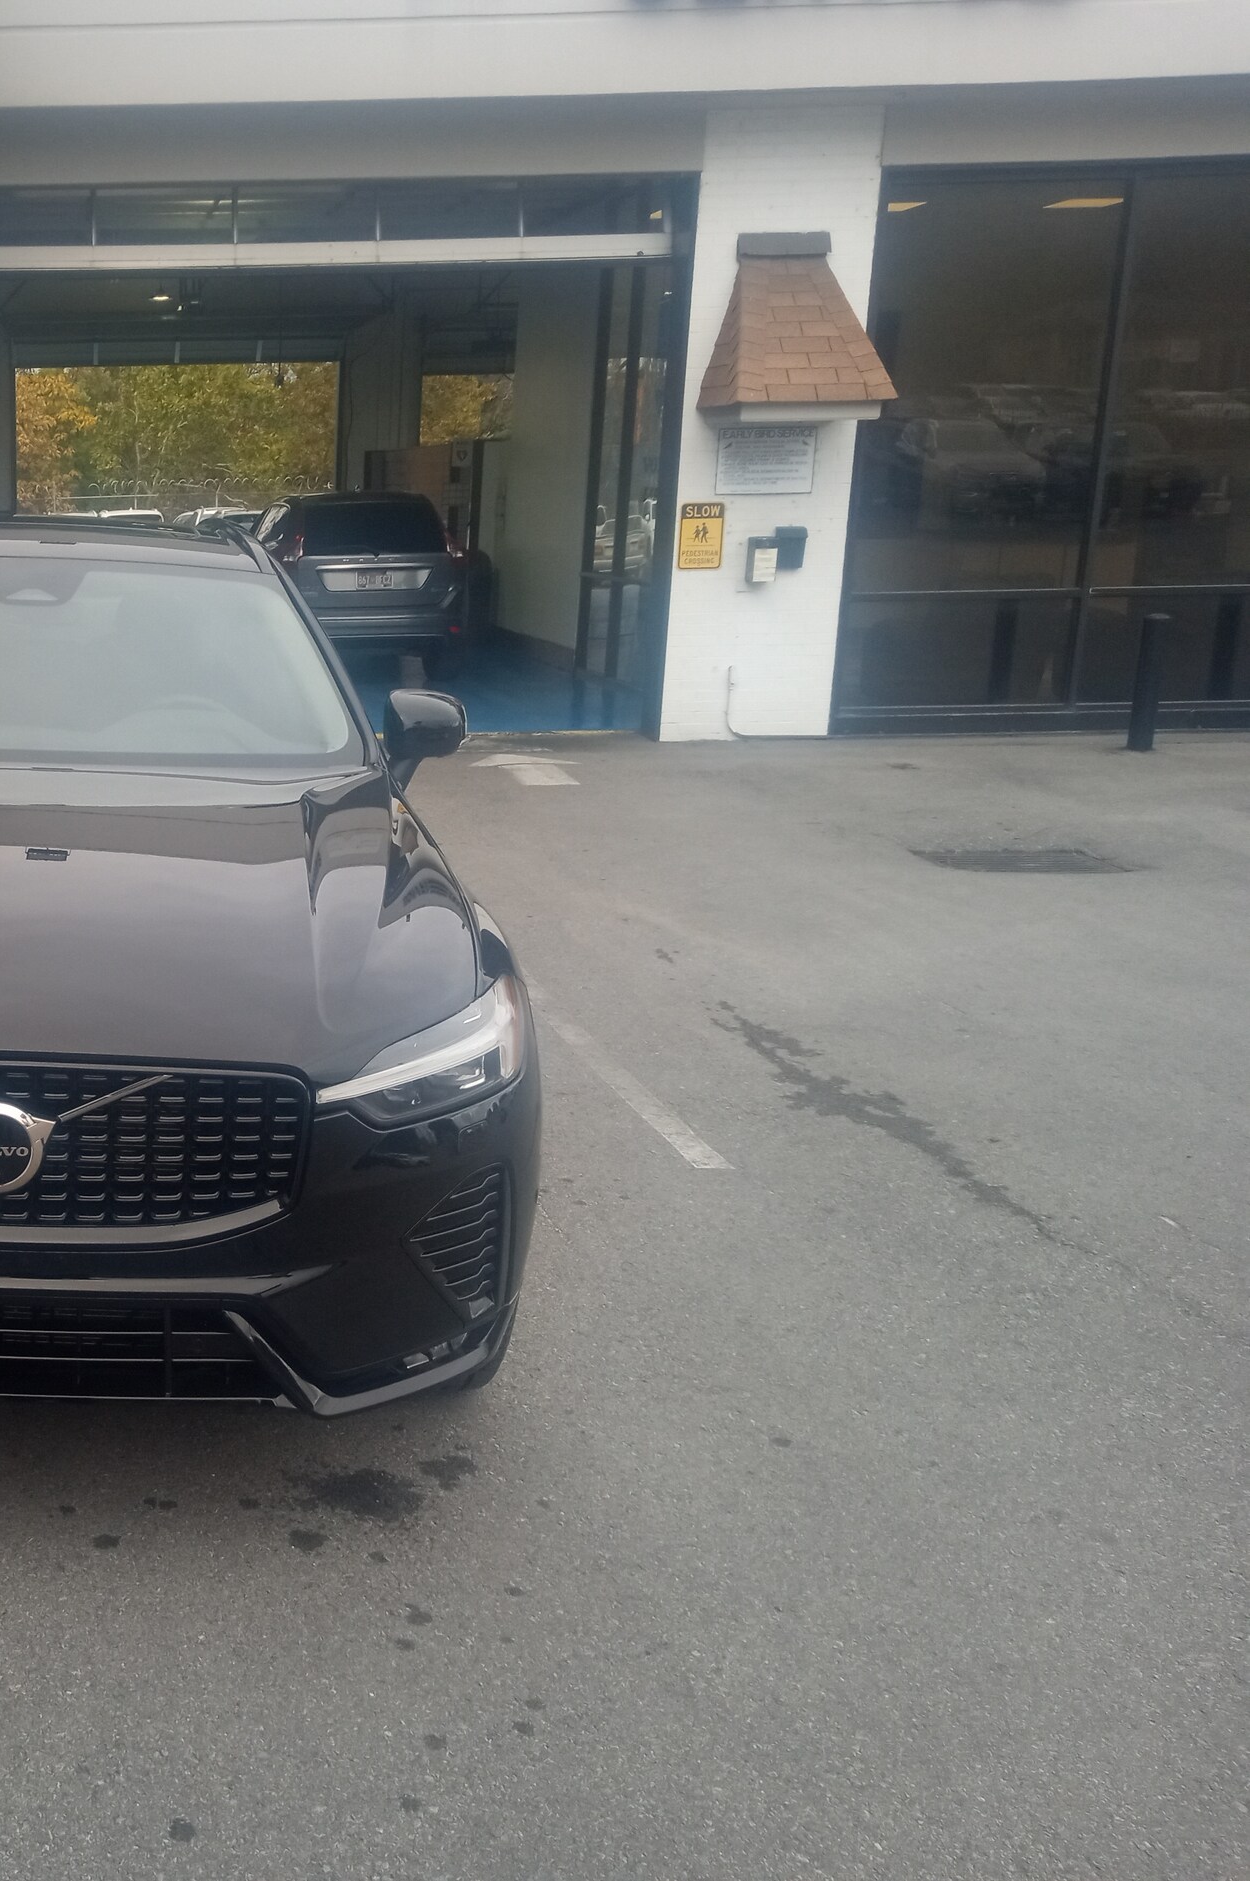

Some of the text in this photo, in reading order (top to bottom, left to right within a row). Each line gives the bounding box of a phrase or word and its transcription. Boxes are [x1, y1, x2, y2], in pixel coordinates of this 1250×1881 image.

[723, 428, 815, 439] EARLY BIRD SERVICE
[685, 505, 721, 517] SLOW
[684, 557, 716, 565] CROSSING
